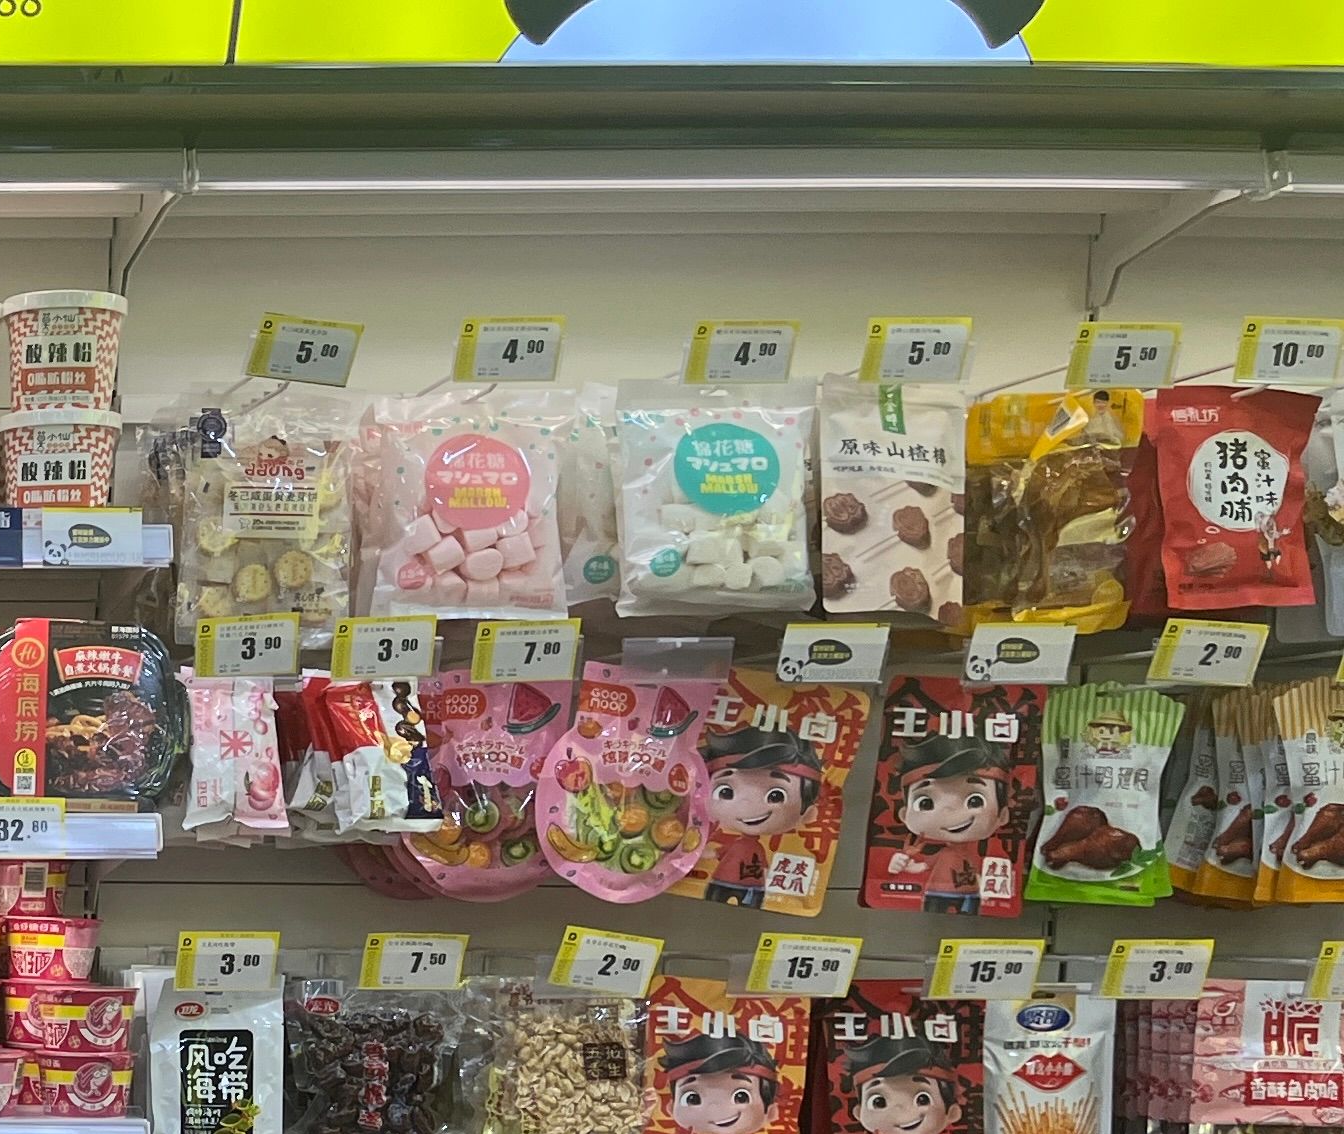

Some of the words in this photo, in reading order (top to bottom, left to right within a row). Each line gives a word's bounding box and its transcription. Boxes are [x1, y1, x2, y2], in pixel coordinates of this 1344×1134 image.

[26, 343, 92, 363] 酸辣粉
[502, 338, 544, 365] 4.90
[733, 342, 777, 365] 4.90
[1115, 346, 1157, 370] 5.50
[21, 461, 87, 481] 酸辣粉
[1214, 440, 1255, 523] 猪肉脯
[241, 636, 282, 660] 3.90
[377, 638, 418, 661] 3.90
[1198, 643, 1241, 667] 2.90
[13, 673, 41, 744] 海底捞
[891, 707, 1020, 744] 王小卤
[774, 856, 808, 877] 虎皮
[770, 877, 804, 893] 凤爪
[411, 951, 448, 974] 7.50
[598, 954, 640, 978] 2.90
[787, 956, 840, 979] 15.90
[969, 961, 1022, 984] 15.90
[1150, 961, 1192, 983] 3.90
[654, 1005, 784, 1043] 王小卤
[834, 1012, 957, 1042] 王小卤
[186, 1037, 249, 1071] 风吃
[186, 1069, 249, 1101] 海带
